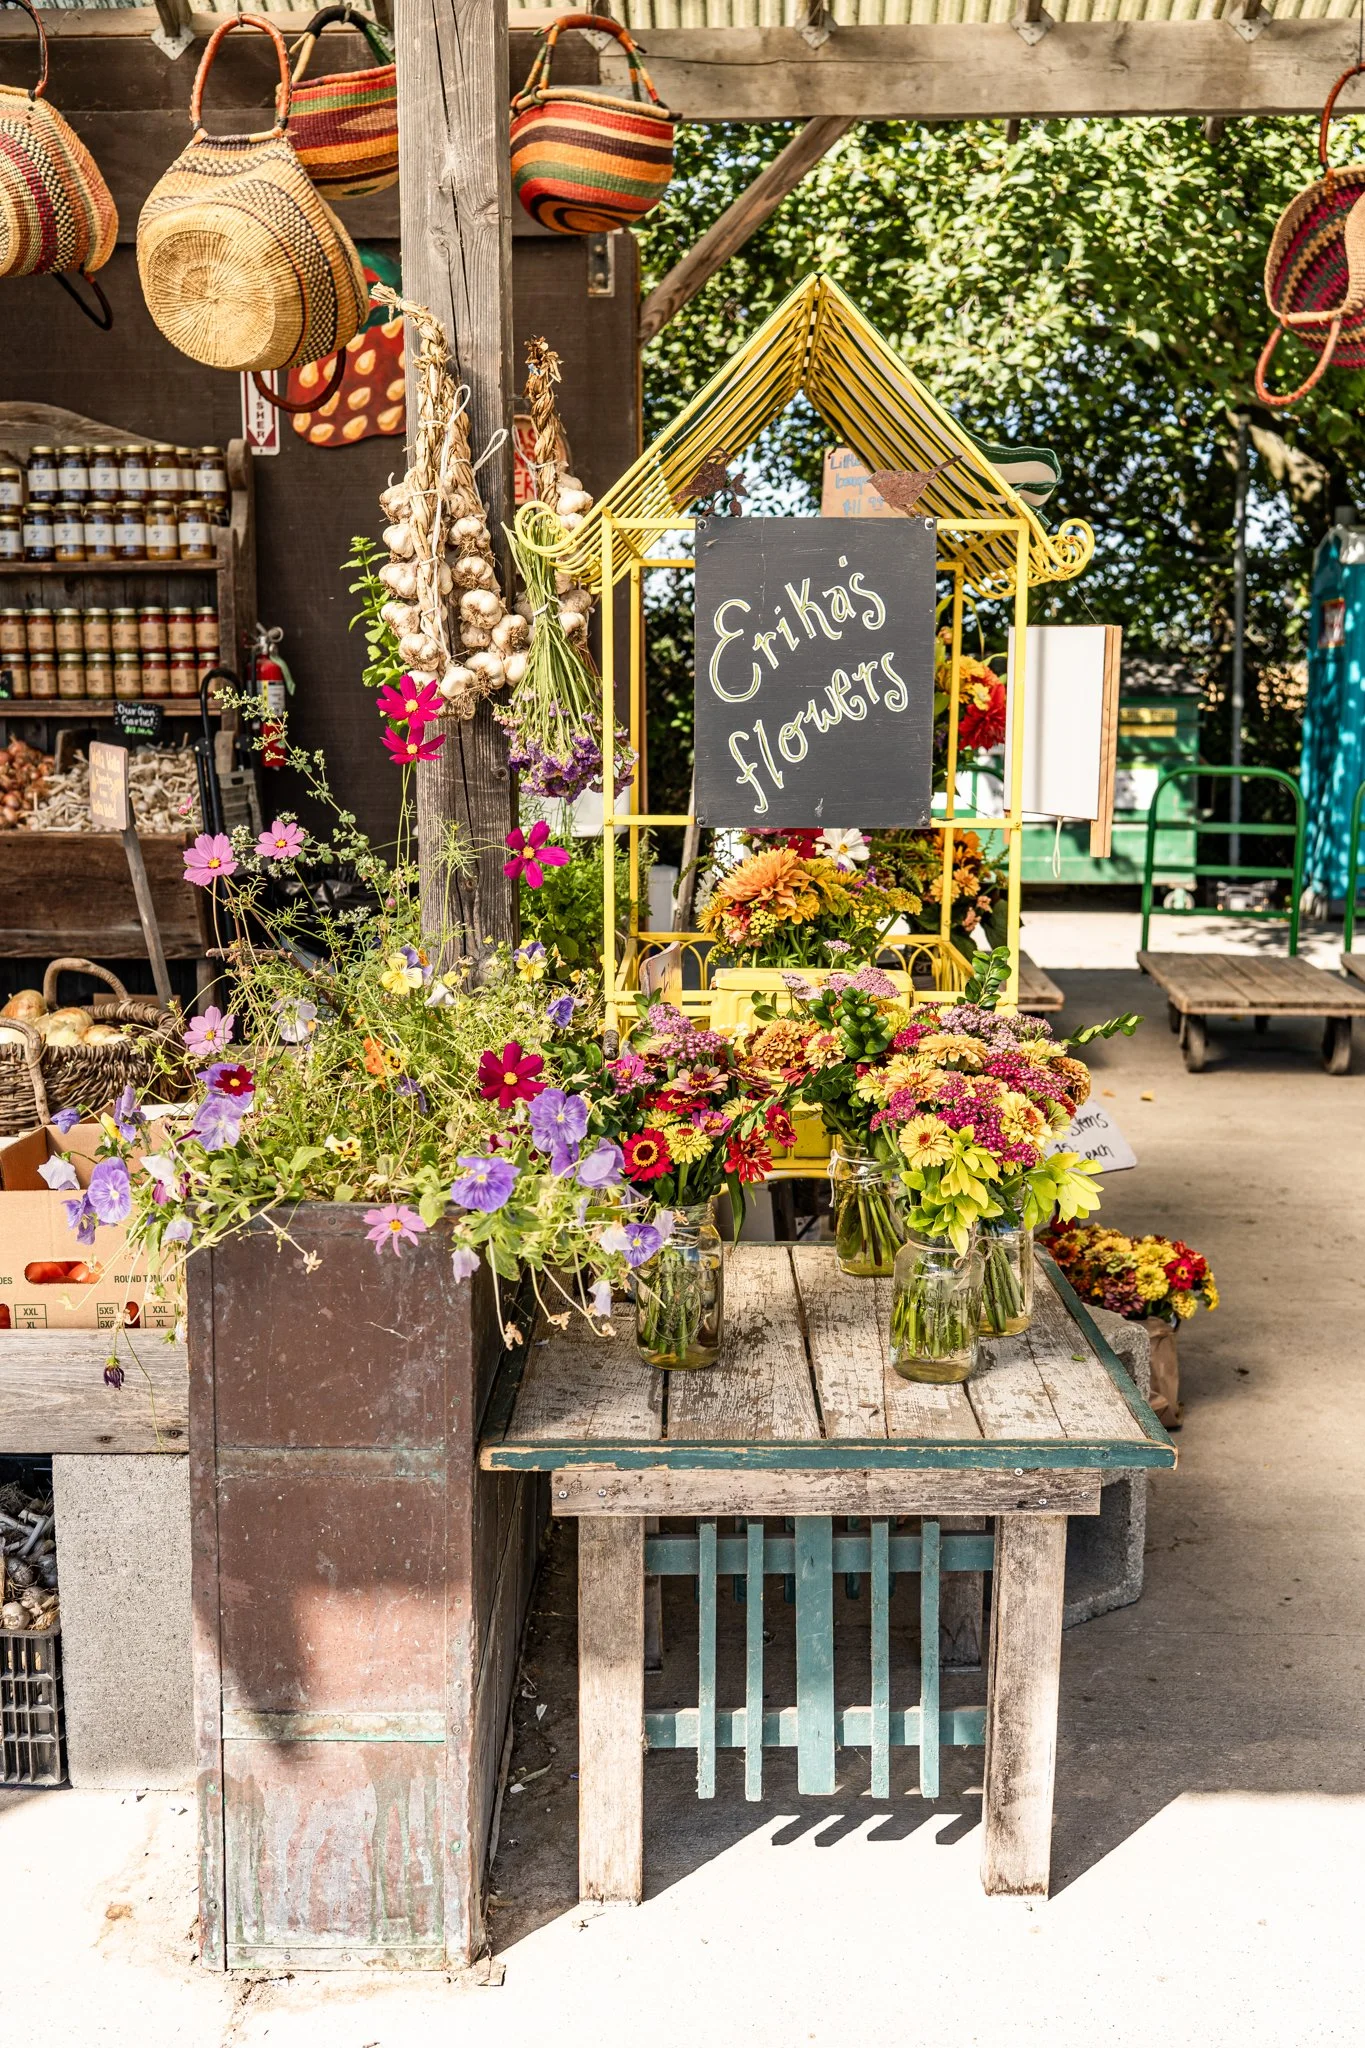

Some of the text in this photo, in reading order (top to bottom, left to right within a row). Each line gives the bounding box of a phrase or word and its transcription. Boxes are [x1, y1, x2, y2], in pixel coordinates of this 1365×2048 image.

[728, 652, 909, 813] flowers
[114, 1273, 176, 1284] ROUND TOMTO
[23, 1307, 38, 1316] XXL
[99, 1306, 114, 1315] 5X5
[152, 1305, 168, 1314] XXL
[26, 1321, 37, 1329] XL
[155, 1319, 167, 1328] XL
